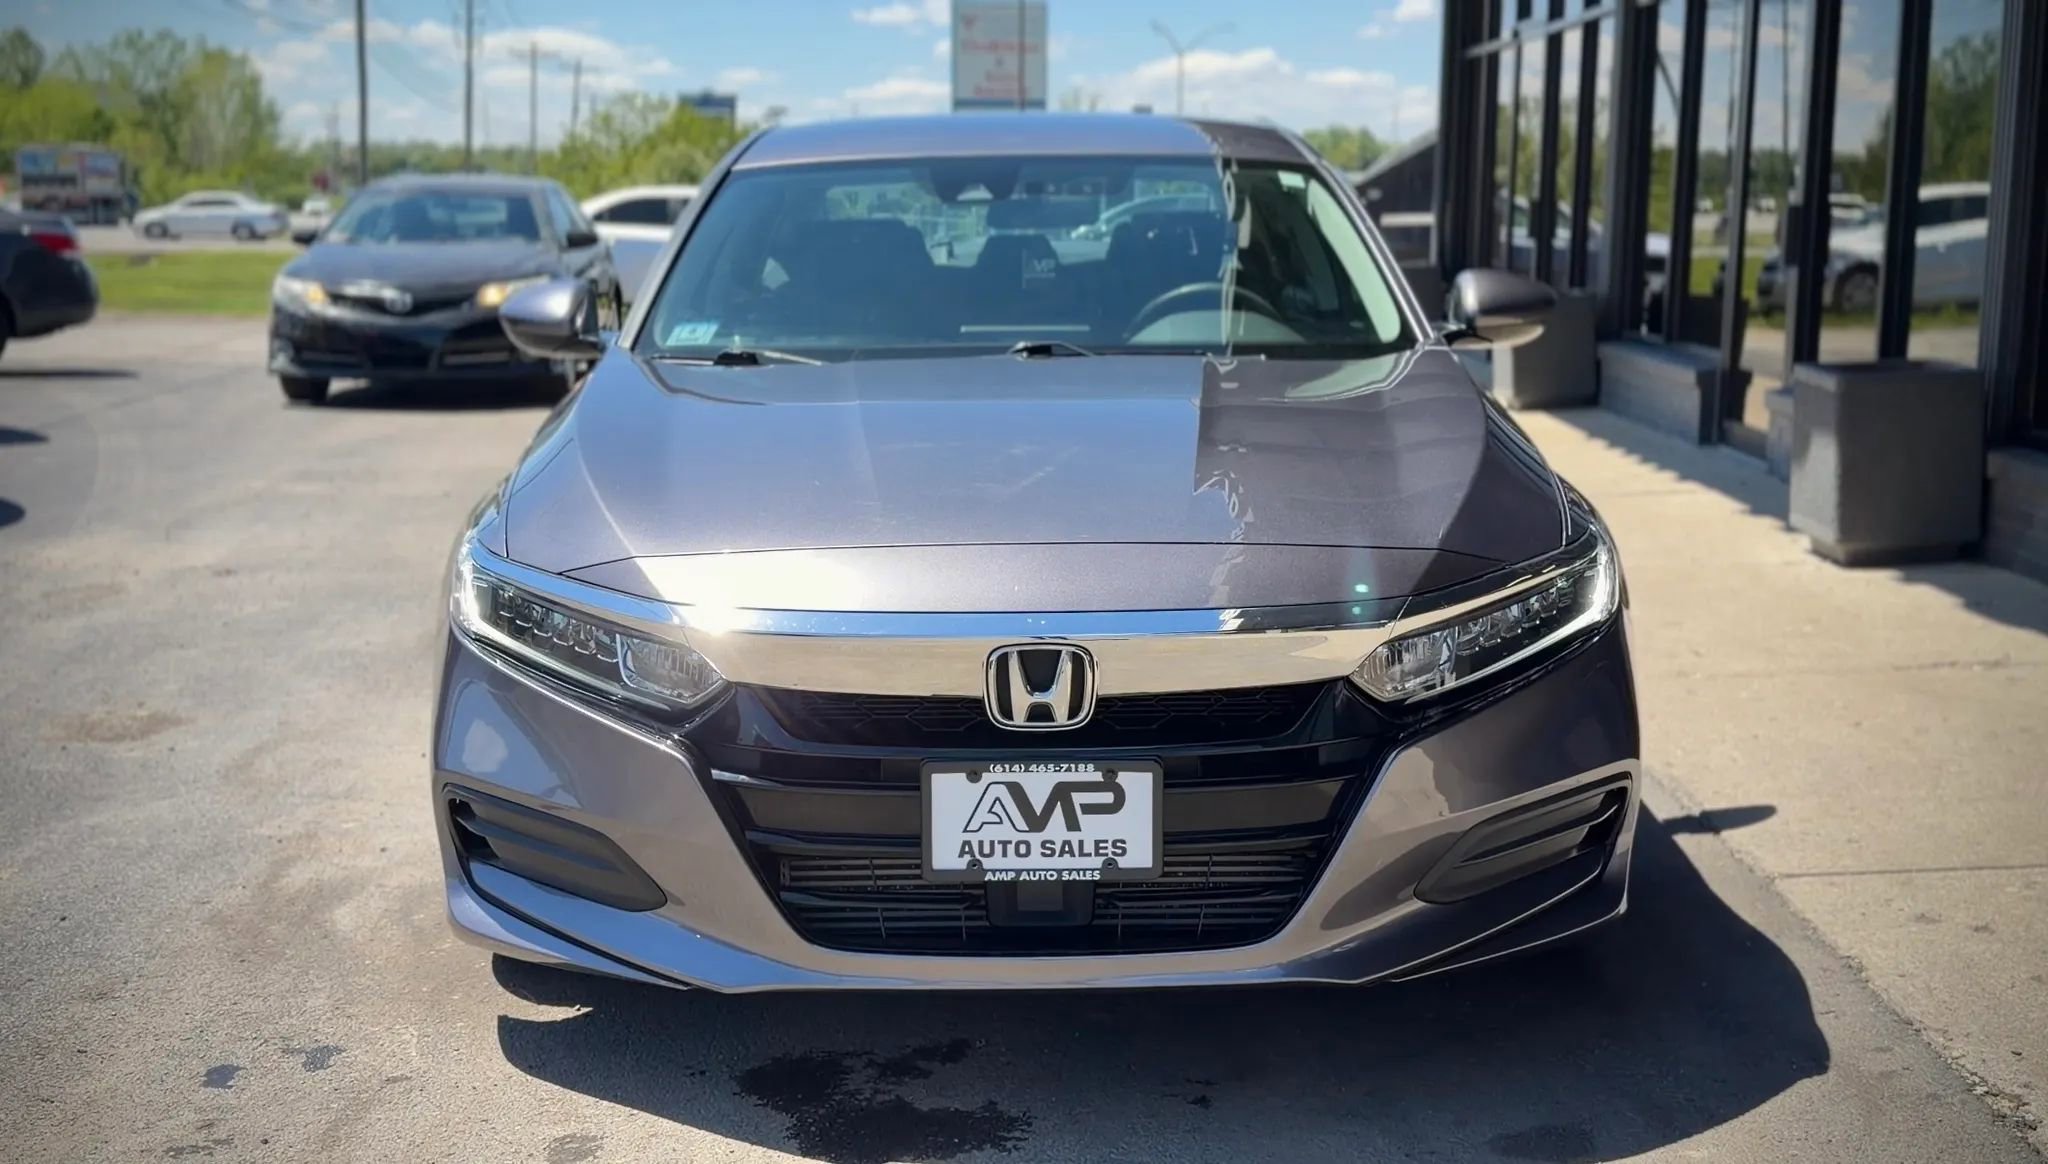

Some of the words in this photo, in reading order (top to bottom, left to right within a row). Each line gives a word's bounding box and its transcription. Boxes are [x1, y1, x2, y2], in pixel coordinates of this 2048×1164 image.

[989, 763, 1025, 773] (614)
[1028, 763, 1095, 773] 465-7188
[957, 839, 1032, 858] AUTO
[1040, 838, 1128, 858] SALES
[984, 870, 1016, 881] AMP
[1019, 870, 1058, 881] AUTO
[1061, 870, 1101, 881] SALES
